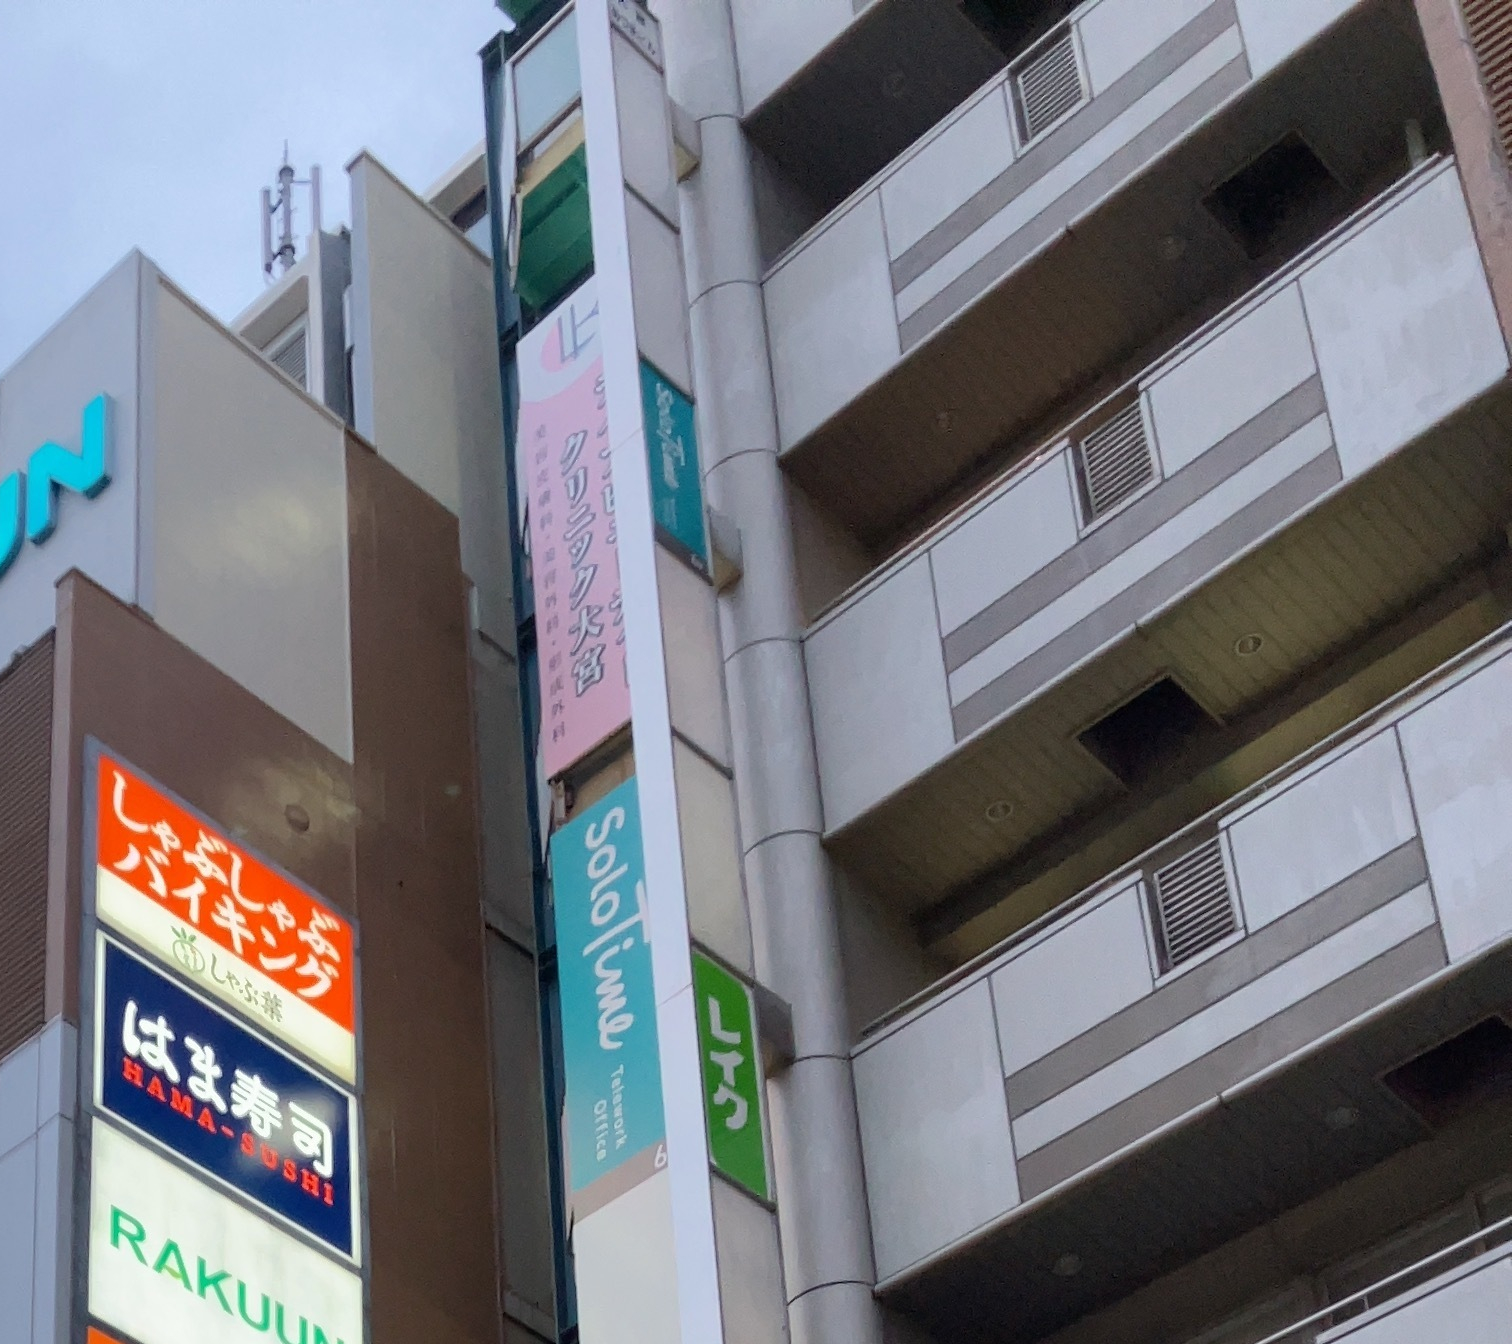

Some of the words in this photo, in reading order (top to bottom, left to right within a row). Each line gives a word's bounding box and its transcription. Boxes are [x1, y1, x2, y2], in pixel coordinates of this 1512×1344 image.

[560, 429, 606, 698] クリニック大宮
[112, 769, 340, 964] しゃぶしゃぶ
[114, 843, 340, 999] バイキング
[208, 957, 284, 1025] しゃぶ葉
[708, 996, 748, 1130] レイク
[121, 999, 334, 1178] はま寿司
[121, 1057, 336, 1206] HAMA-SUSHI
